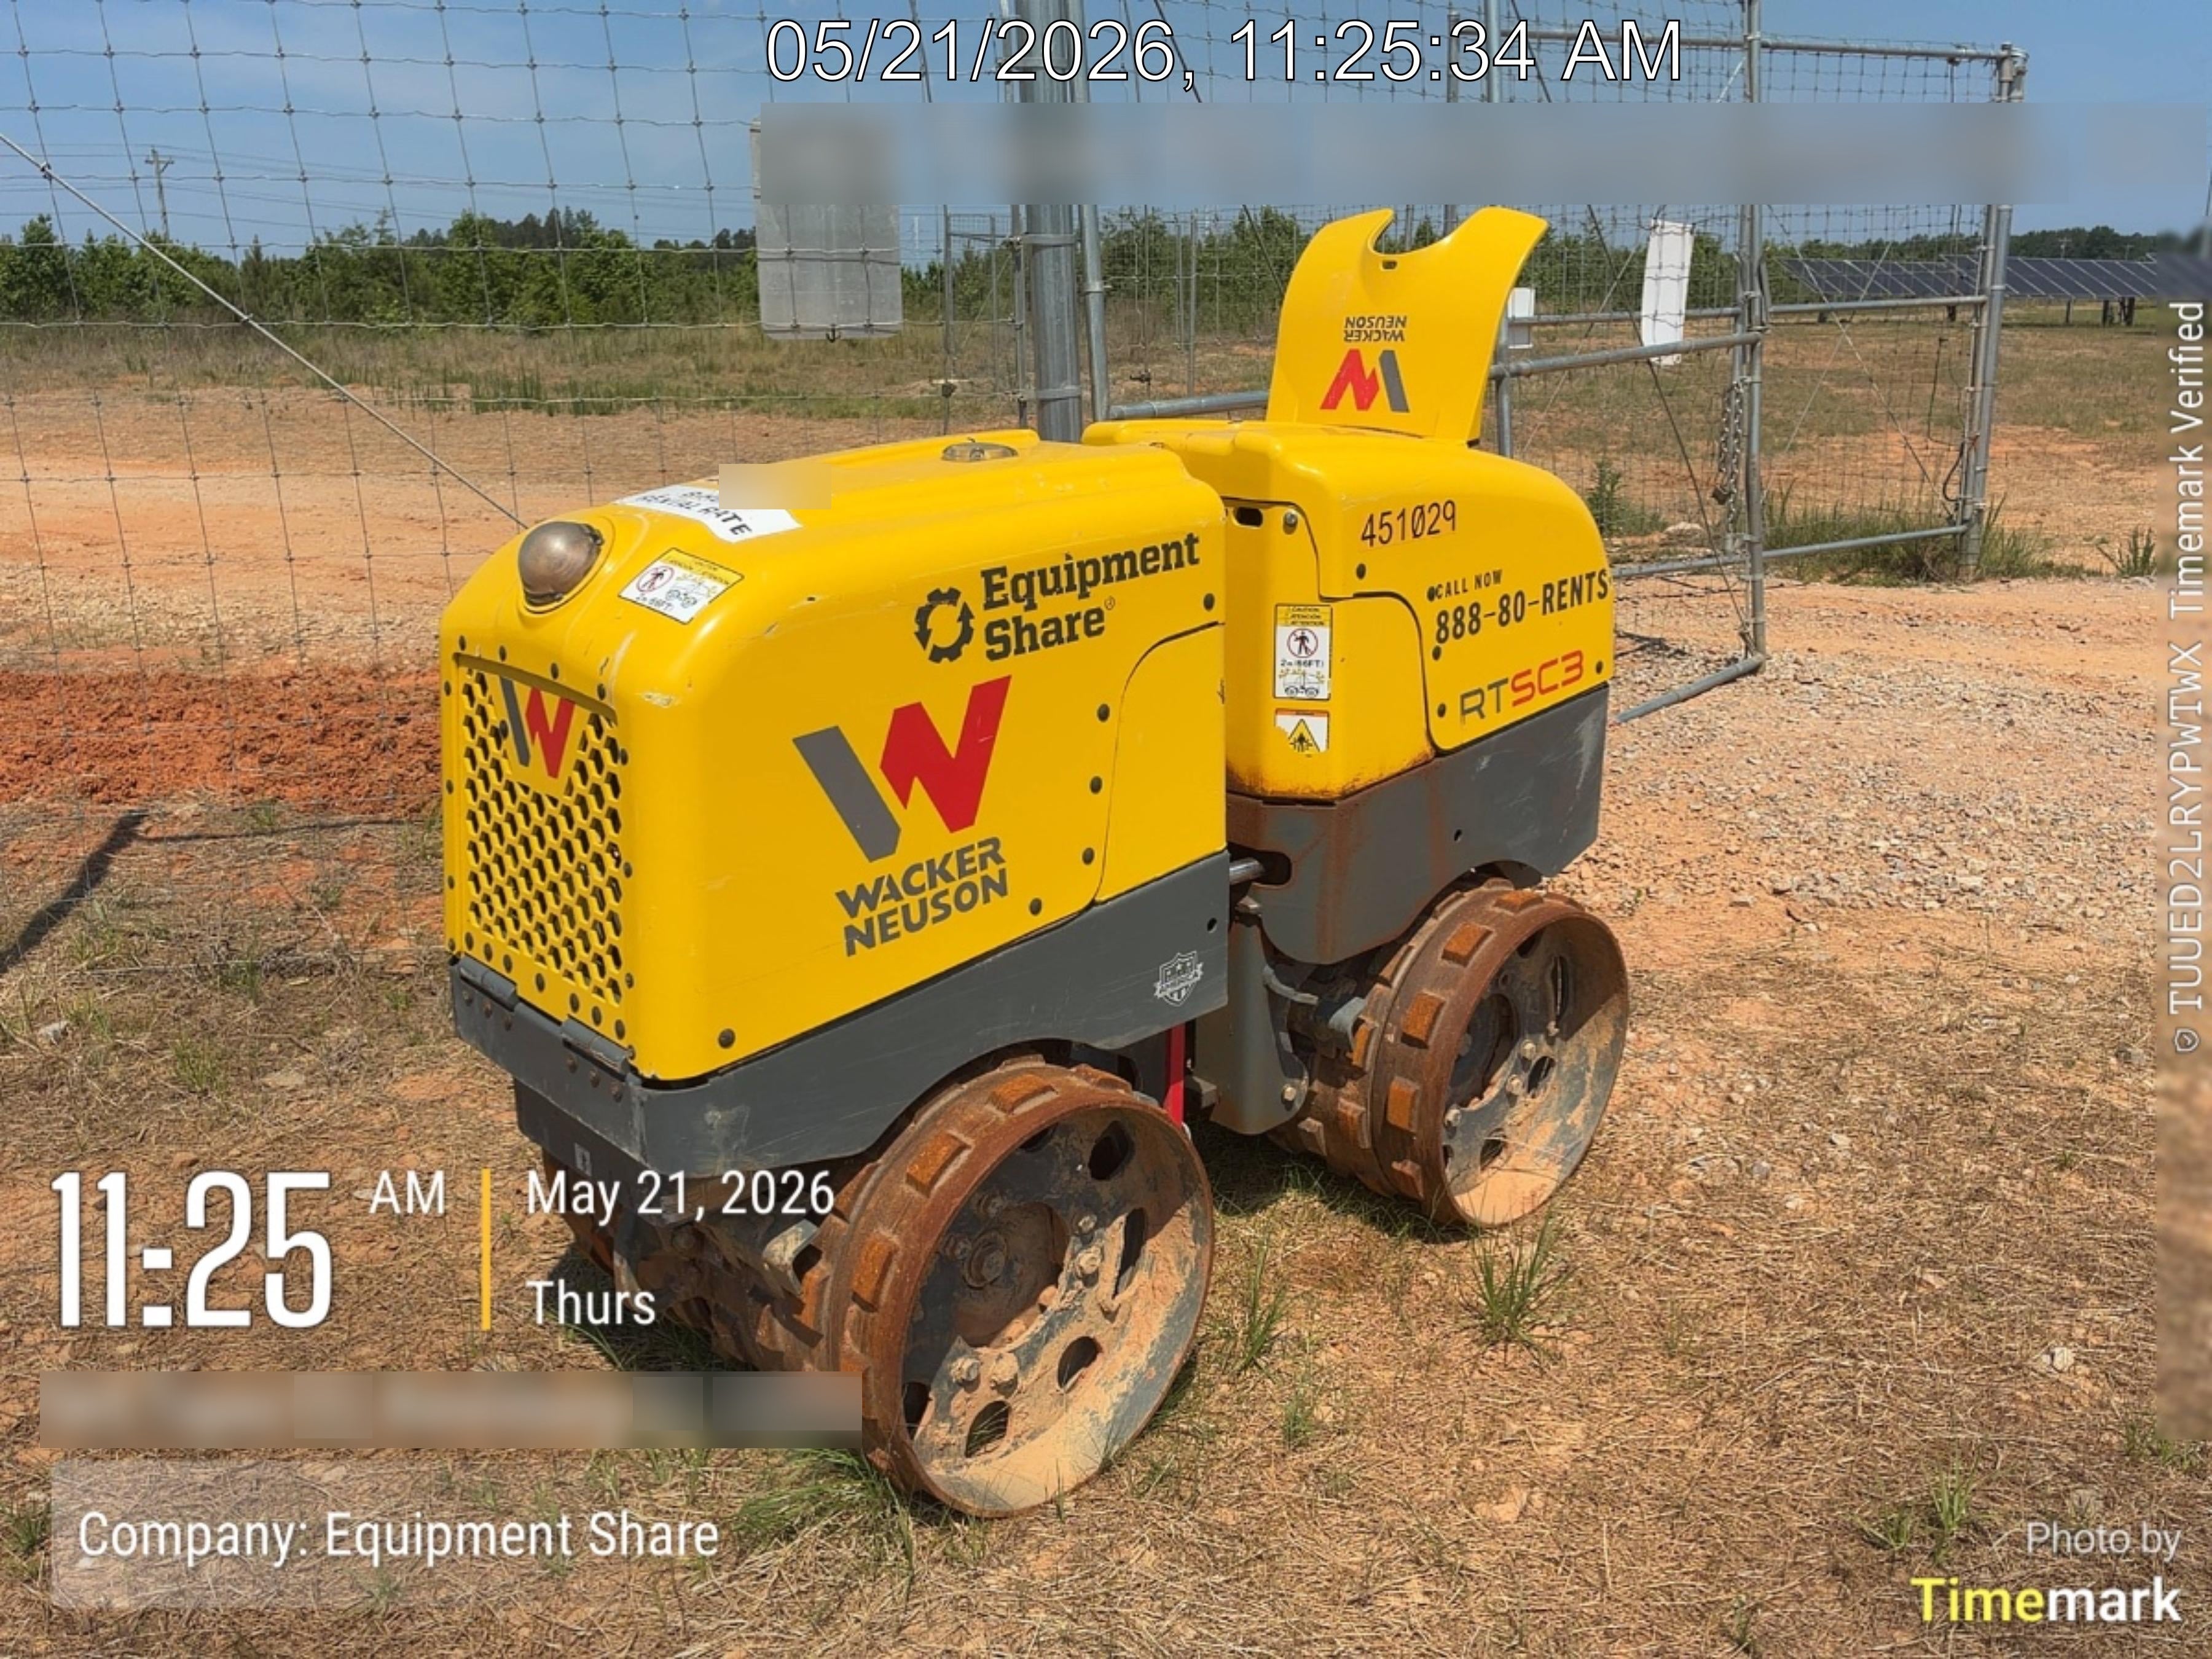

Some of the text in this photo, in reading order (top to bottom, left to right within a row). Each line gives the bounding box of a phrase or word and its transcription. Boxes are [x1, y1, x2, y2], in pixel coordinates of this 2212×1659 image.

[1344, 315, 1407, 329] NEUSON
[1344, 329, 1405, 342] WACKER
[1360, 500, 1456, 547] 451029
[981, 532, 1199, 612] Equipment
[1435, 569, 1502, 599] CALL NOW
[1435, 568, 1609, 644] 888-80-RENTS
[1459, 650, 1584, 724] RTSC3
[835, 836, 1006, 919] WACKER
[844, 868, 1008, 957] NEUSON
